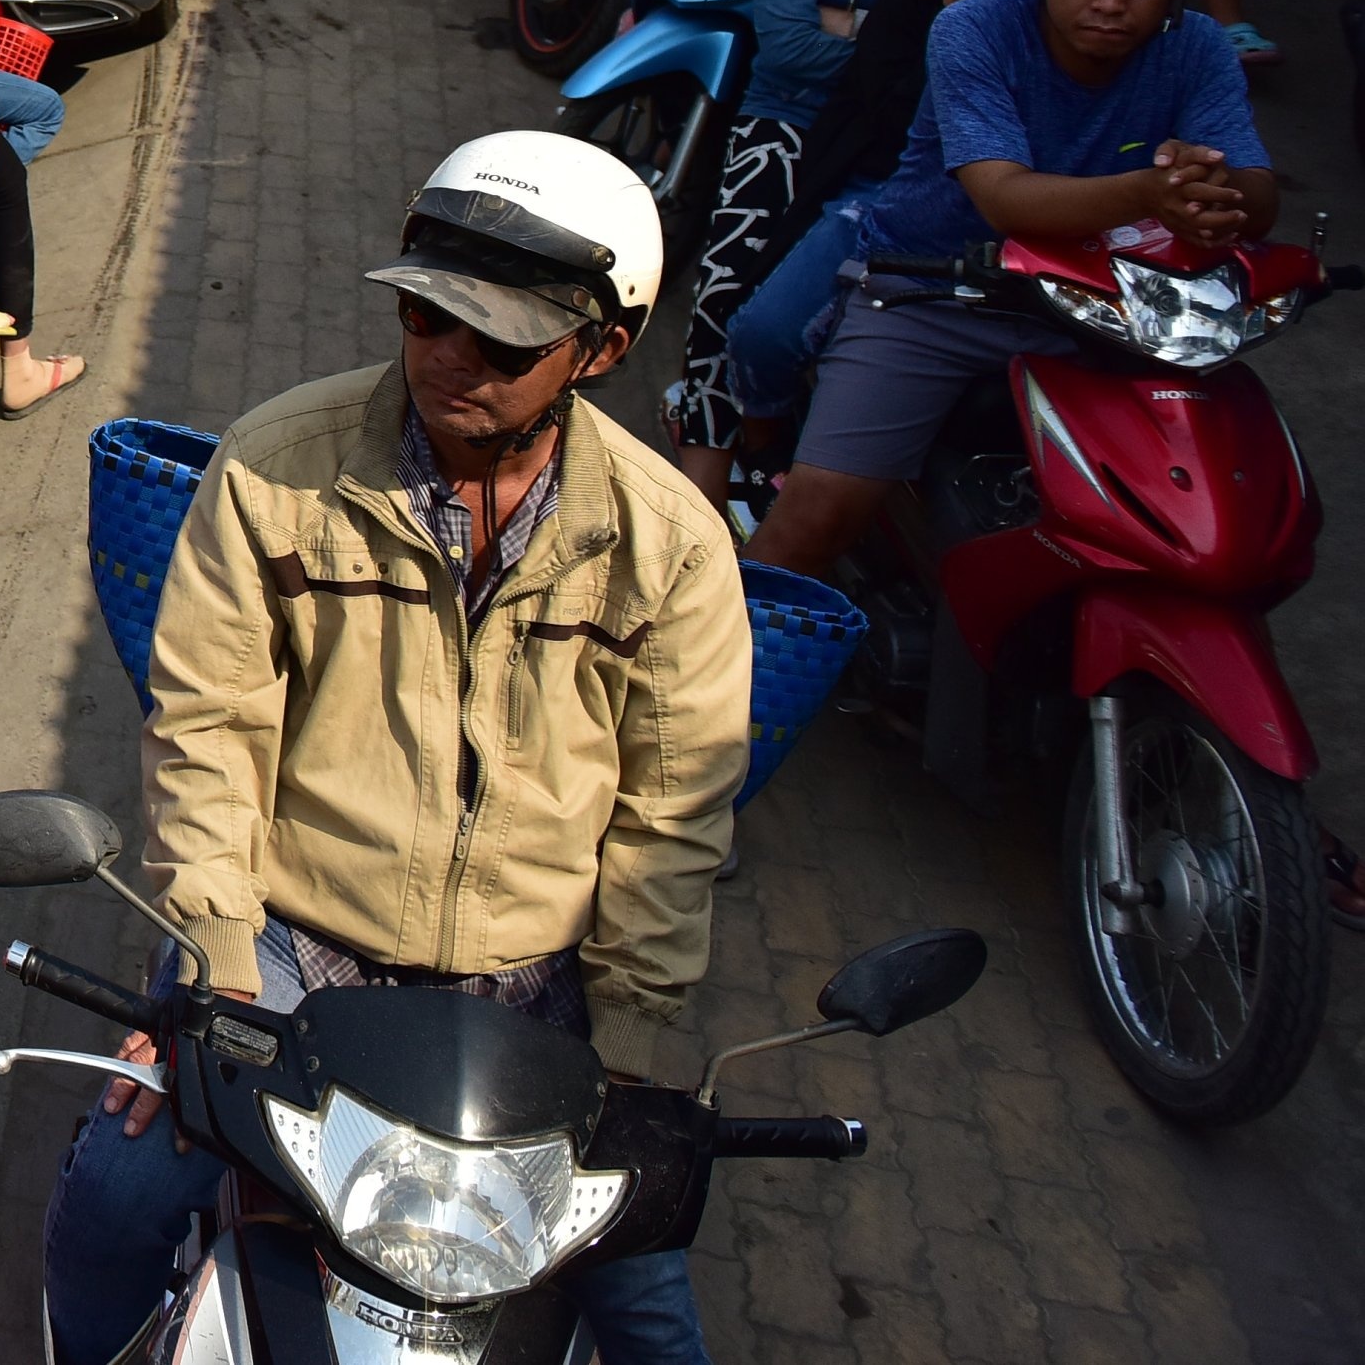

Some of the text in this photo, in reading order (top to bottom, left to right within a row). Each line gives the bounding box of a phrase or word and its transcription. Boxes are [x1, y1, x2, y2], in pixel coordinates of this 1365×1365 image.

[473, 172, 541, 196] HONDA
[1032, 530, 1082, 569] HONDA
[358, 1301, 460, 1344] HONDA
